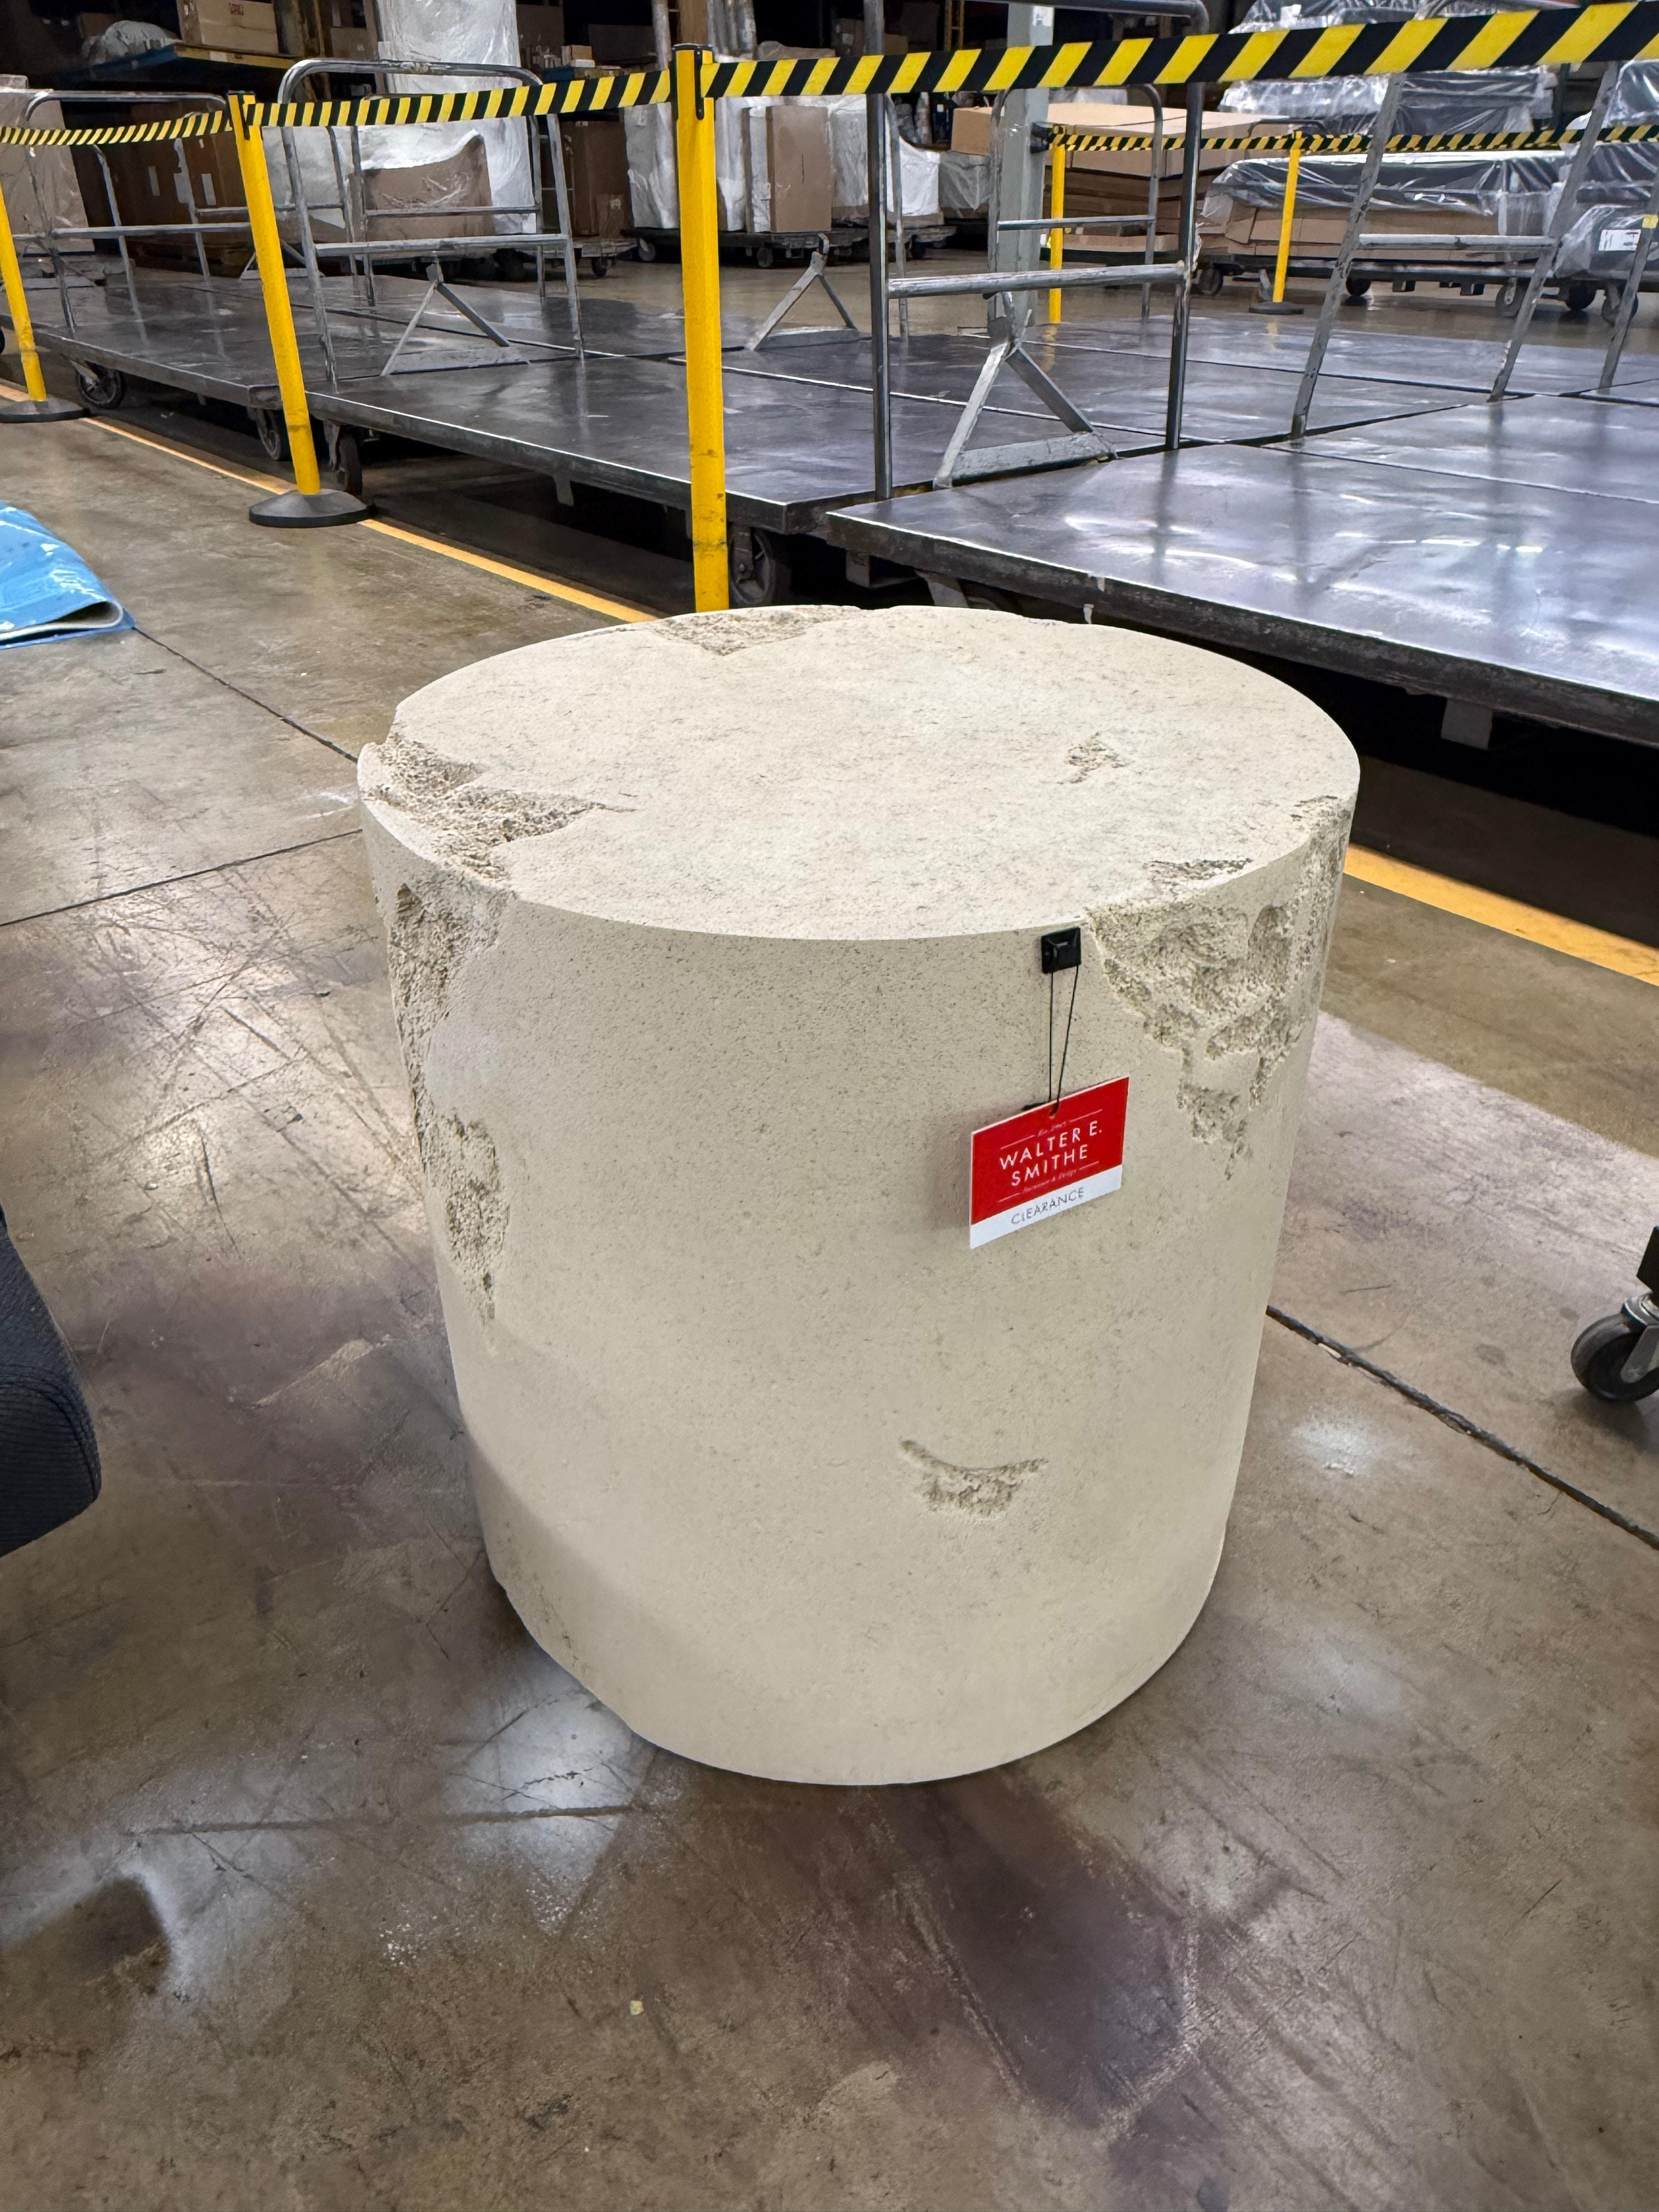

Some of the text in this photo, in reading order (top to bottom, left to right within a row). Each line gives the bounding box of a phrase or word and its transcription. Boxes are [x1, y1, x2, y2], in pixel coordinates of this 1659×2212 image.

[999, 1127, 1081, 1170] WALTER
[1089, 1120, 1103, 1137] E.
[1011, 1144, 1088, 1186] SMITHE
[1011, 1187, 1085, 1224] CLEARANCE
